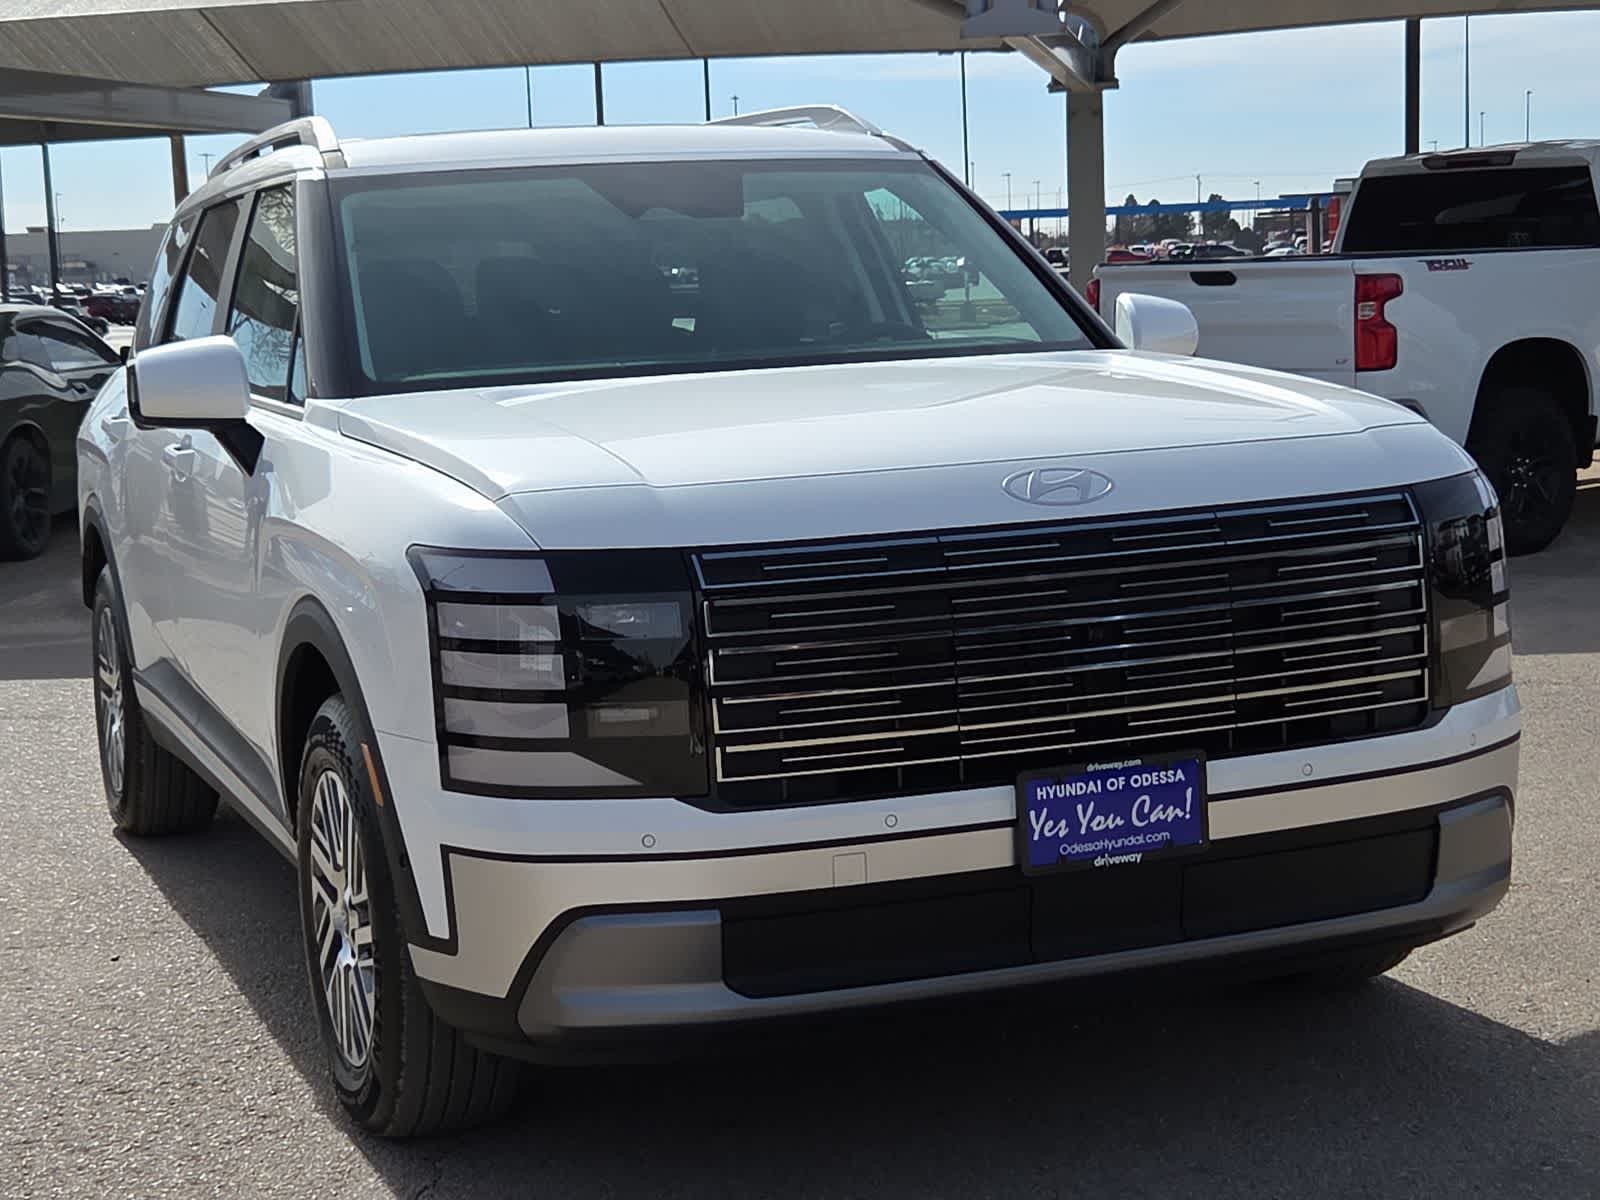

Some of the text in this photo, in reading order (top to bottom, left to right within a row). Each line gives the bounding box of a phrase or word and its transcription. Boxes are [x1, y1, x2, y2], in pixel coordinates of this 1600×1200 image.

[1087, 758, 1142, 772] driveway.com
[1037, 769, 1185, 800] HYUNDAI OF ODESSA
[1029, 787, 1193, 841] Yes You Can!
[1059, 831, 1170, 855] OdessaHyundai.com
[1094, 853, 1142, 867] driveway
